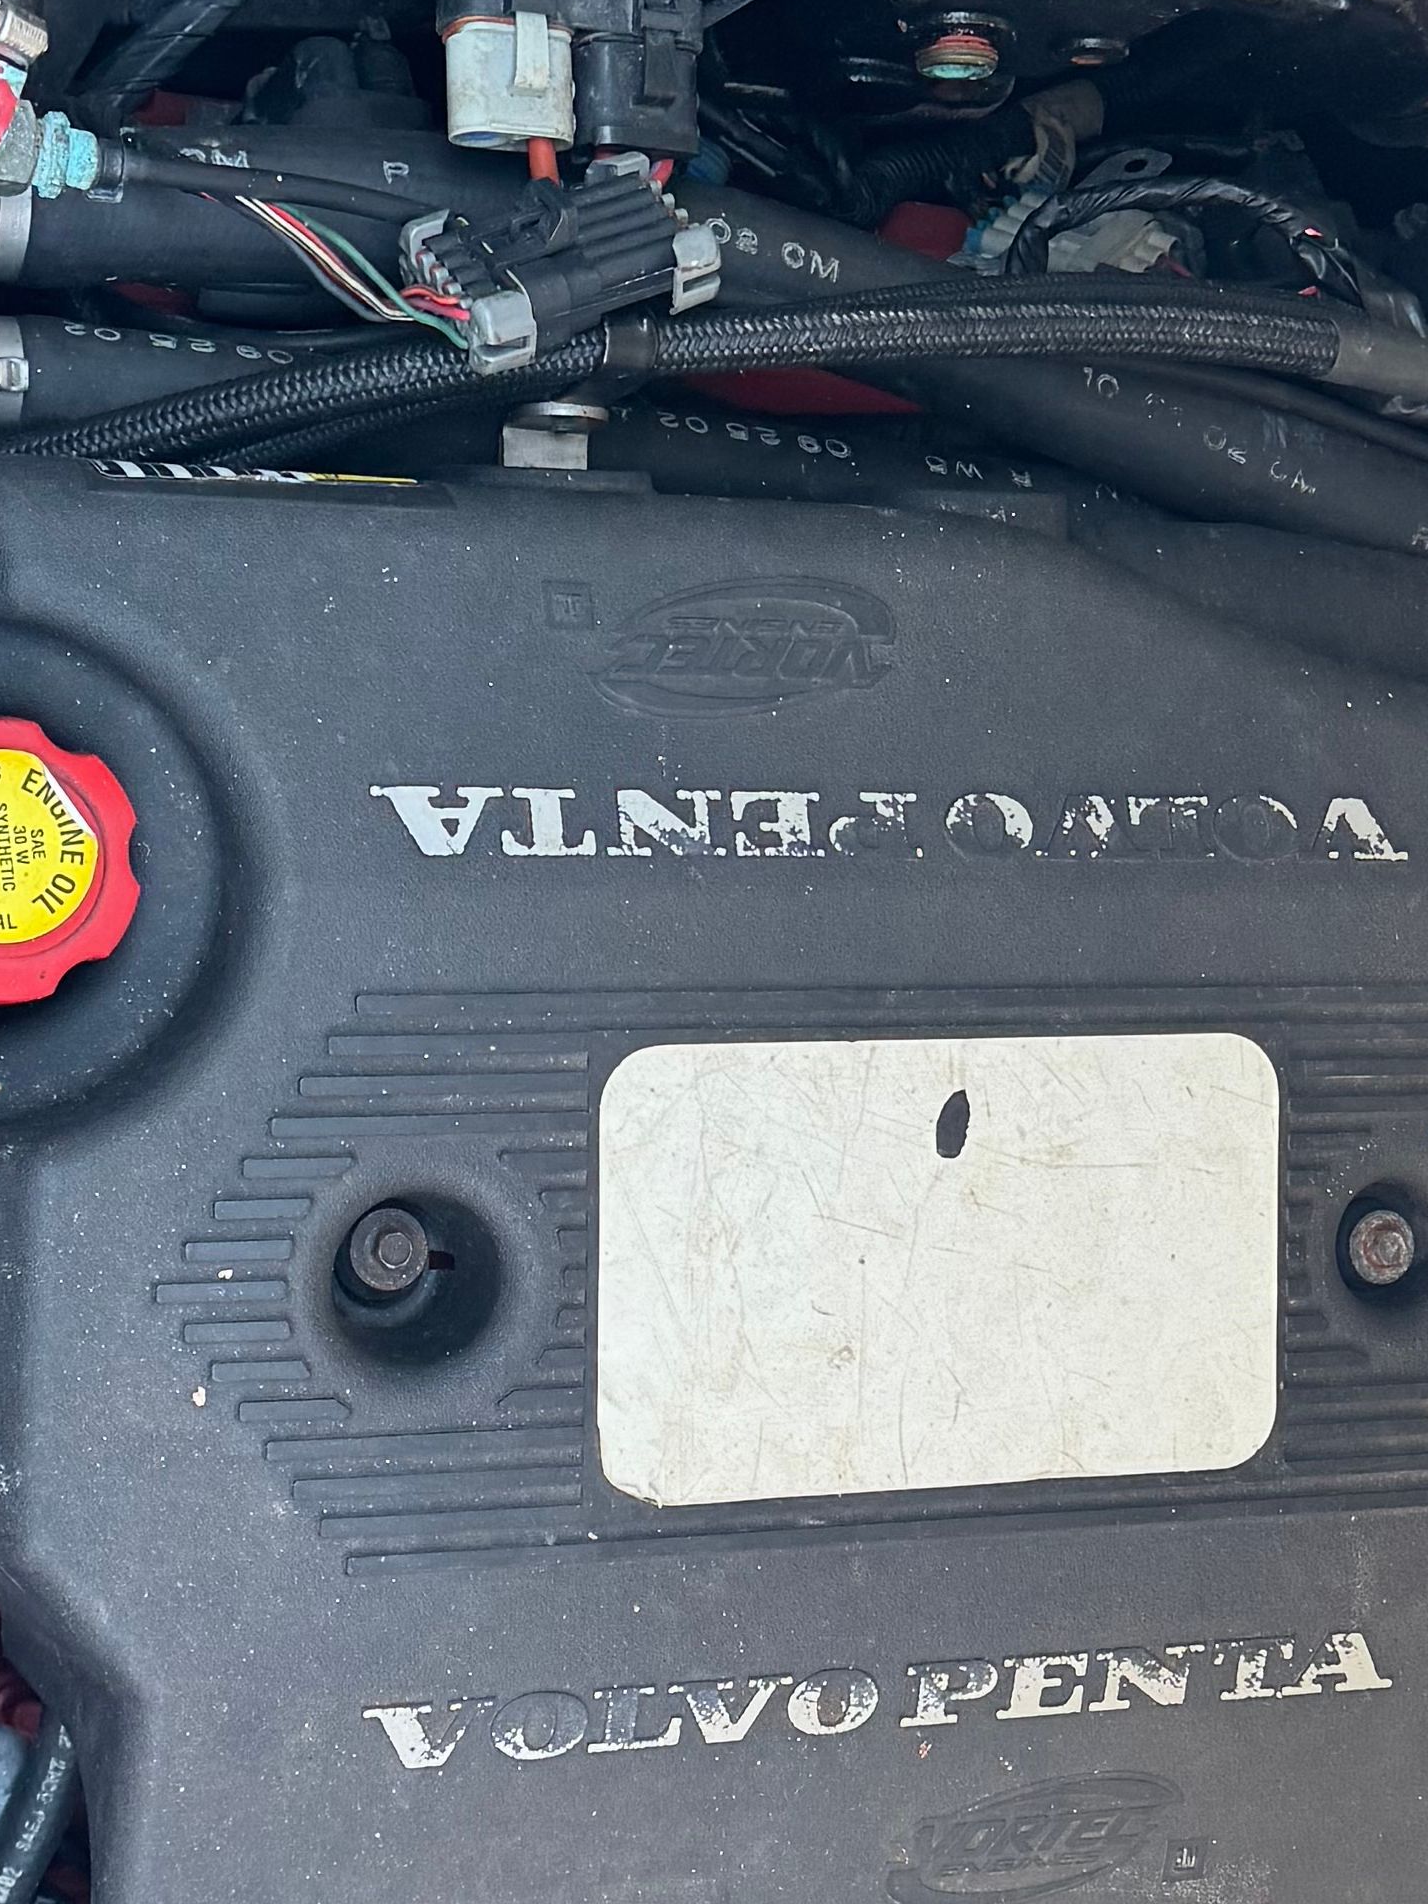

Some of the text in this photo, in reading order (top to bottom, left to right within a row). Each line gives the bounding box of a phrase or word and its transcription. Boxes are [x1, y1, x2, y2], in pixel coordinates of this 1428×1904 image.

[14, 825, 31, 865] 30 W
[21, 767, 85, 915] ENGINE OIL
[30, 828, 46, 860] SAE
[370, 785, 921, 860] PENTA
[362, 1631, 1393, 1771] VOLVO PENTA
